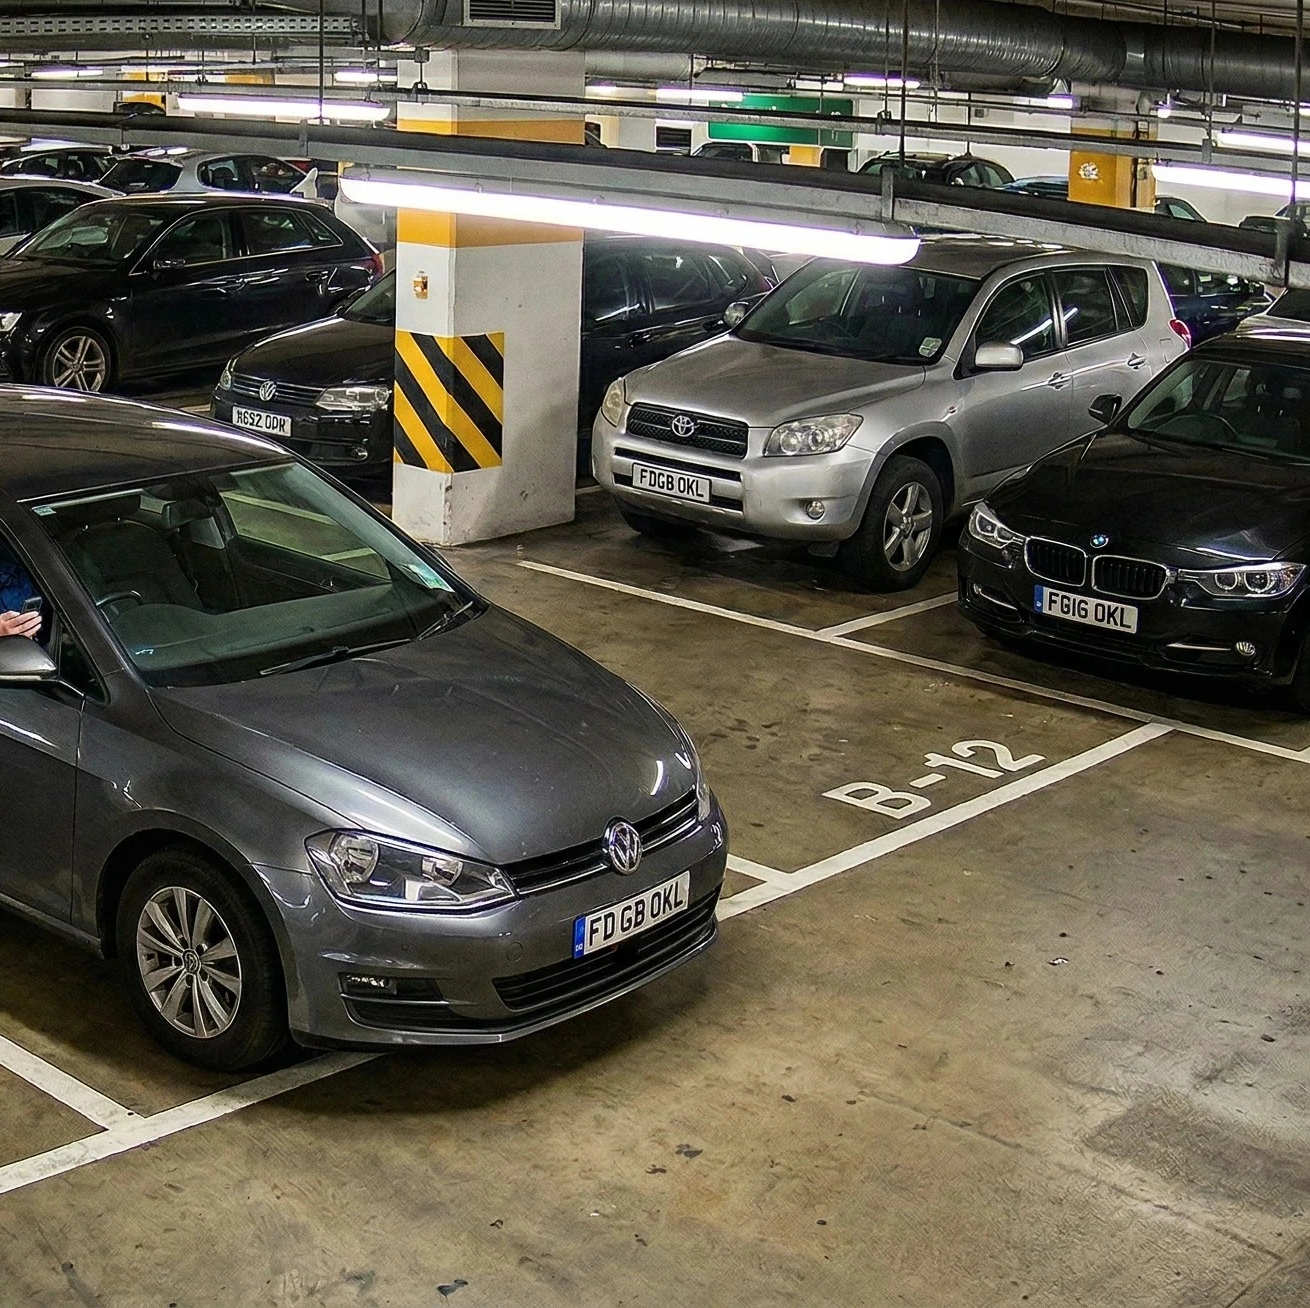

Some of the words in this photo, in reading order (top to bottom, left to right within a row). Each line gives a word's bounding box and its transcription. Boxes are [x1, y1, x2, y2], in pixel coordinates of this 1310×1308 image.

[639, 468, 675, 491] FDGB
[677, 476, 705, 498] OKL
[1093, 602, 1133, 629] OKL
[821, 739, 1047, 820] B-12
[588, 913, 616, 947] FD
[620, 898, 646, 933] GB
[650, 880, 684, 919] OKL
